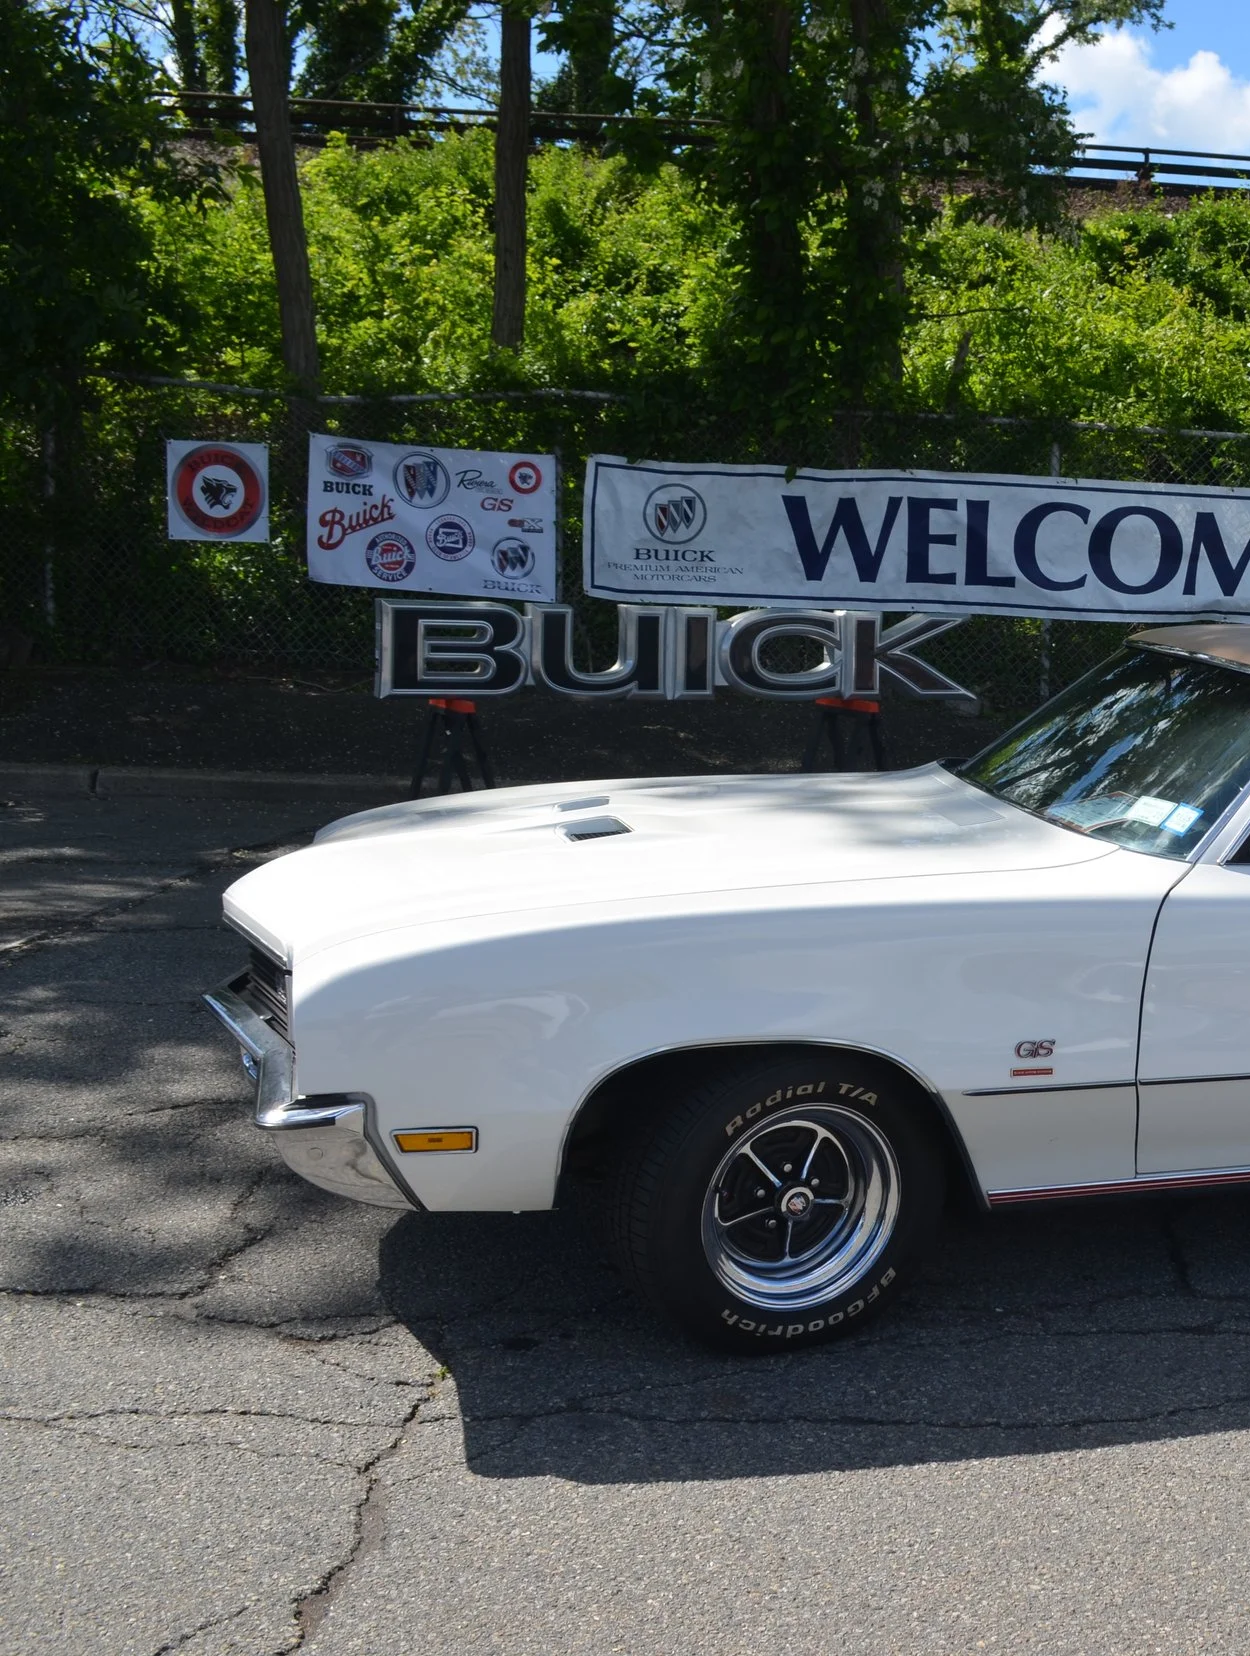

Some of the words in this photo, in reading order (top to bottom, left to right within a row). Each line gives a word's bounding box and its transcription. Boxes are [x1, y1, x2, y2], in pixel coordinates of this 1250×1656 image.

[323, 481, 373, 496] BUICK
[480, 497, 514, 512] GS
[317, 494, 396, 550] Buick
[371, 545, 412, 565] Buick
[633, 547, 716, 562] BUICK
[372, 566, 407, 581] SERVICE
[607, 562, 670, 572] PREMIUM
[675, 565, 743, 575] AMERICAN
[633, 573, 717, 583] MOTORCARS
[483, 579, 543, 594] BUICK
[374, 599, 979, 700] BUICK
[1015, 1039, 1056, 1058] GS
[725, 1081, 826, 1137] Radial
[838, 1082, 879, 1106] T/A
